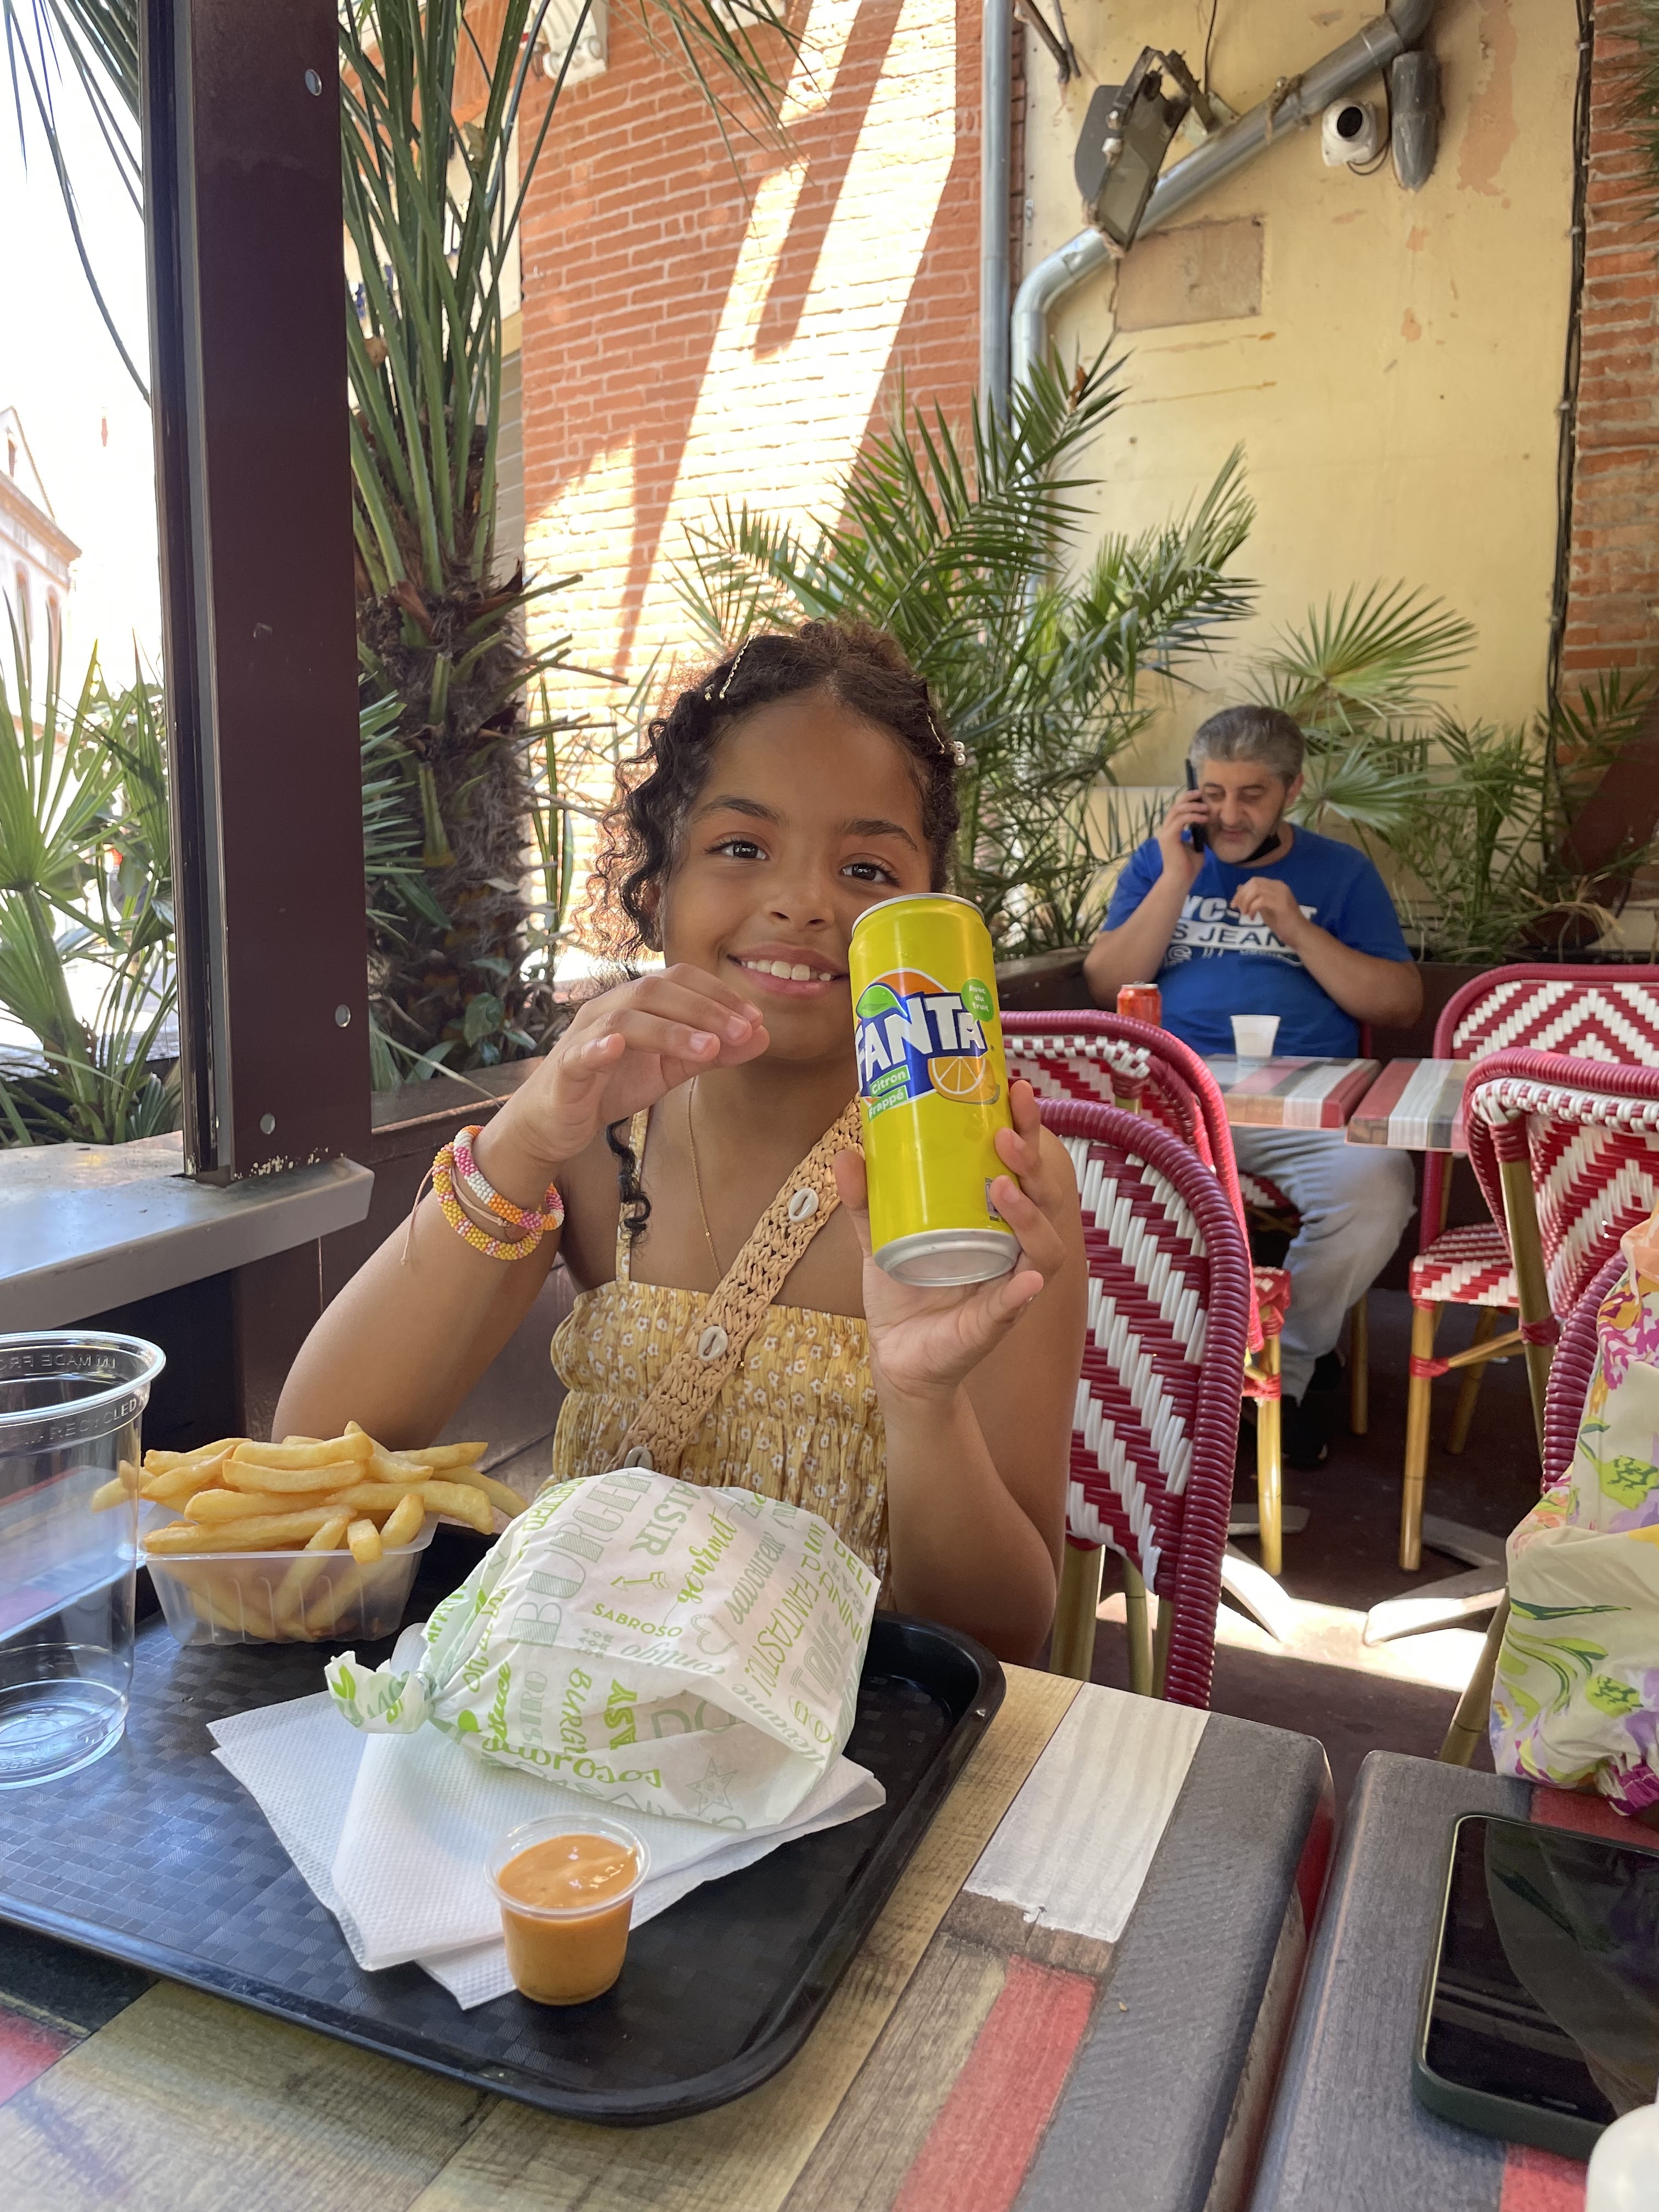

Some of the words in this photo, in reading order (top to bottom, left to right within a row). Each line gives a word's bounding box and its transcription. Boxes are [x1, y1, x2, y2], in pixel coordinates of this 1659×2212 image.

[1198, 926, 1286, 948] JEAN
[974, 994, 985, 1002] du
[855, 996, 986, 1094] FANTA
[871, 1071, 906, 1094] Citron
[629, 1481, 701, 1556] AISIR
[506, 1470, 658, 1647] BURGER
[676, 1505, 738, 1604] gourmet
[833, 1538, 872, 1597] DELI
[592, 1603, 682, 1637] SABROSO
[744, 1570, 820, 1697] FANTASTIC!
